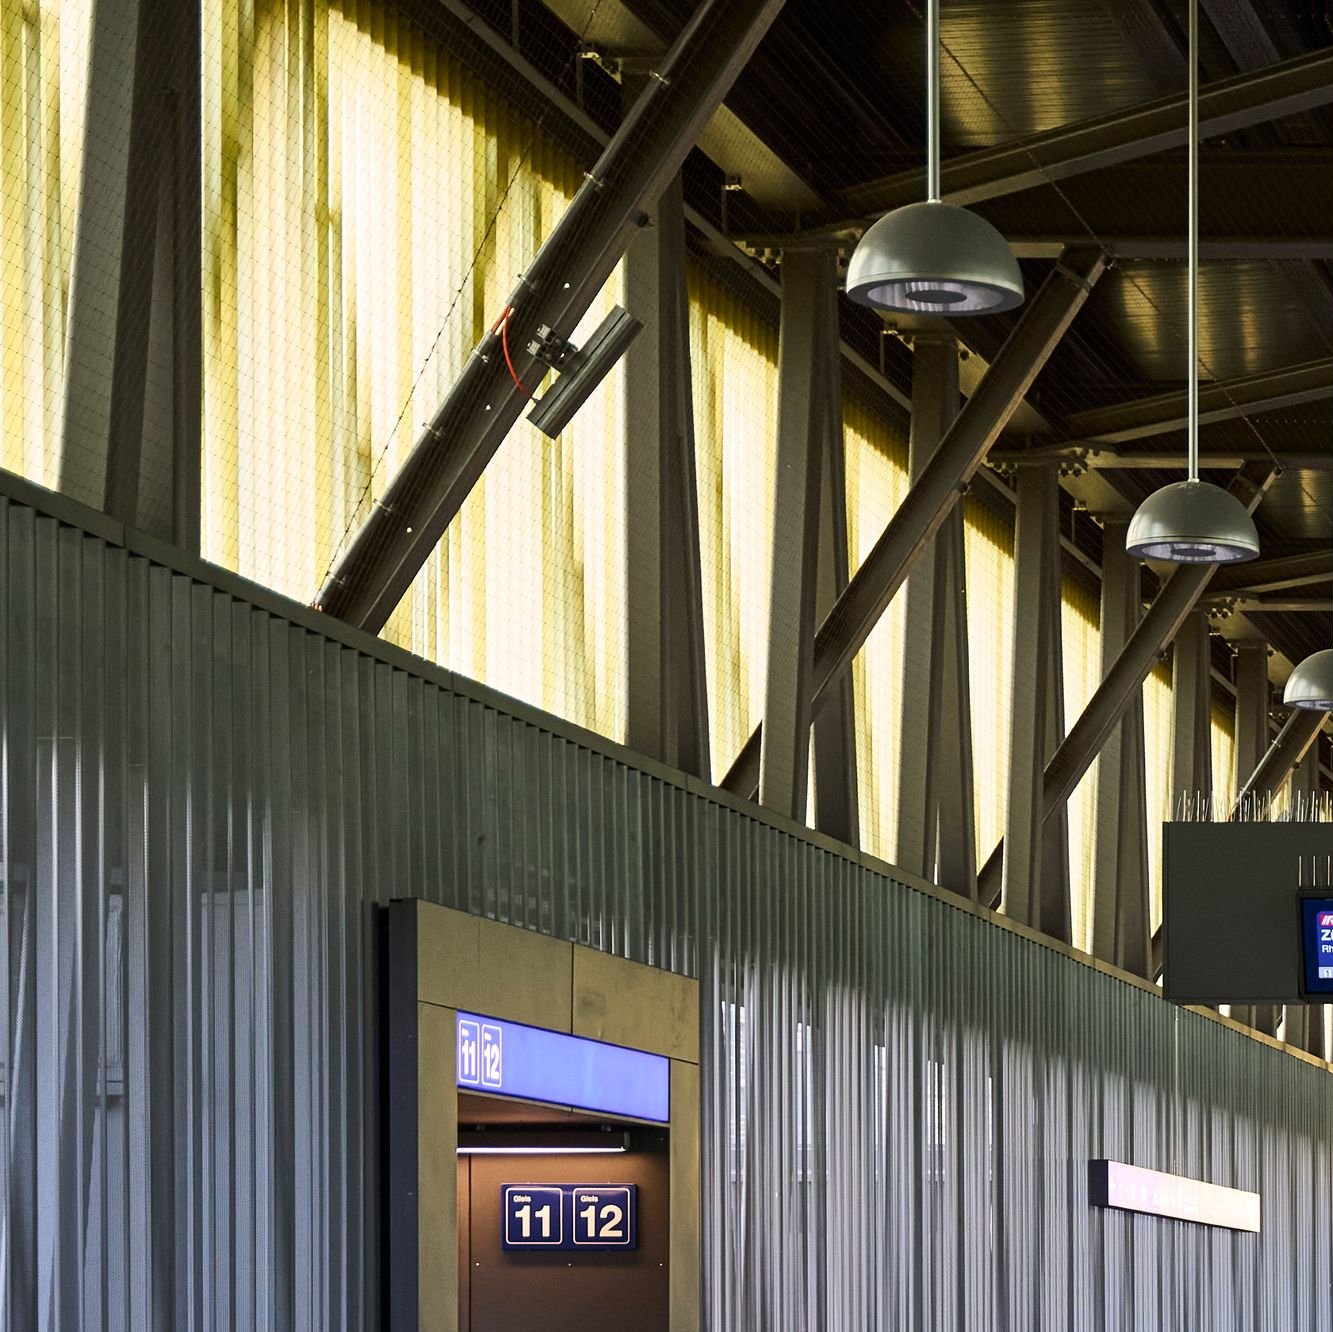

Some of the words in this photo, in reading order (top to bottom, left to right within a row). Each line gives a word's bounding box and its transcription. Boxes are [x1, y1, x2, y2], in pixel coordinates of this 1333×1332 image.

[462, 1039, 476, 1076] 11
[484, 1043, 500, 1080] 12
[515, 1205, 551, 1238] 11
[580, 1204, 623, 1238] 12
